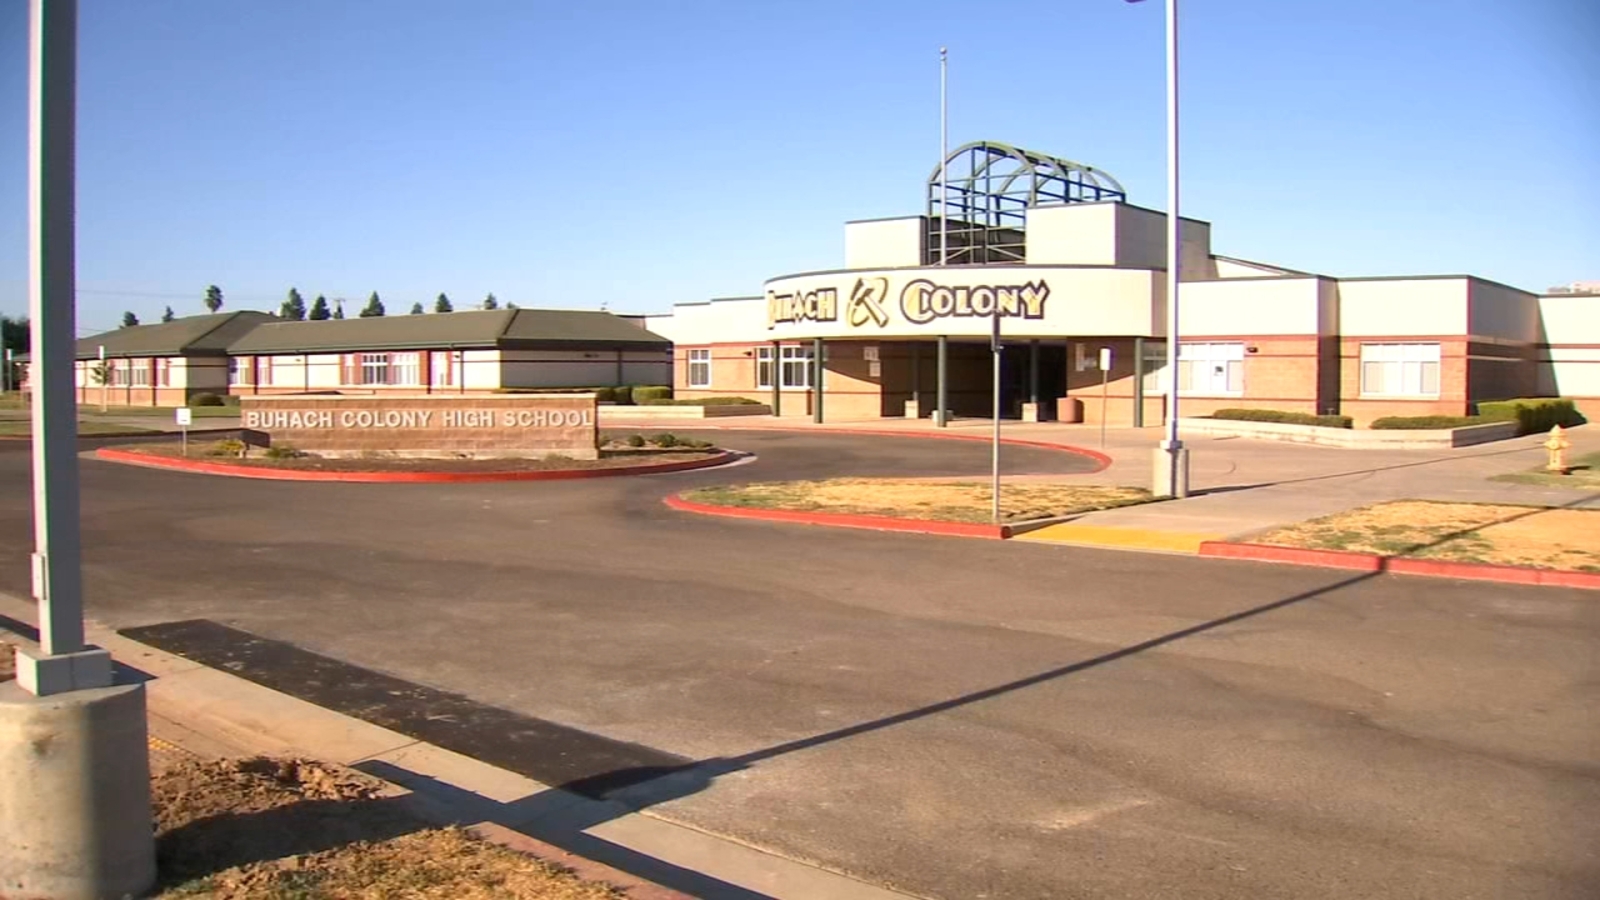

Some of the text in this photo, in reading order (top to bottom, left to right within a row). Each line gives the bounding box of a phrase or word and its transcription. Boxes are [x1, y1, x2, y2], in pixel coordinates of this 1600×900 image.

[900, 278, 1049, 325] COLONY
[246, 409, 594, 429] BUHACH COLONY HIGH SCHOOL
